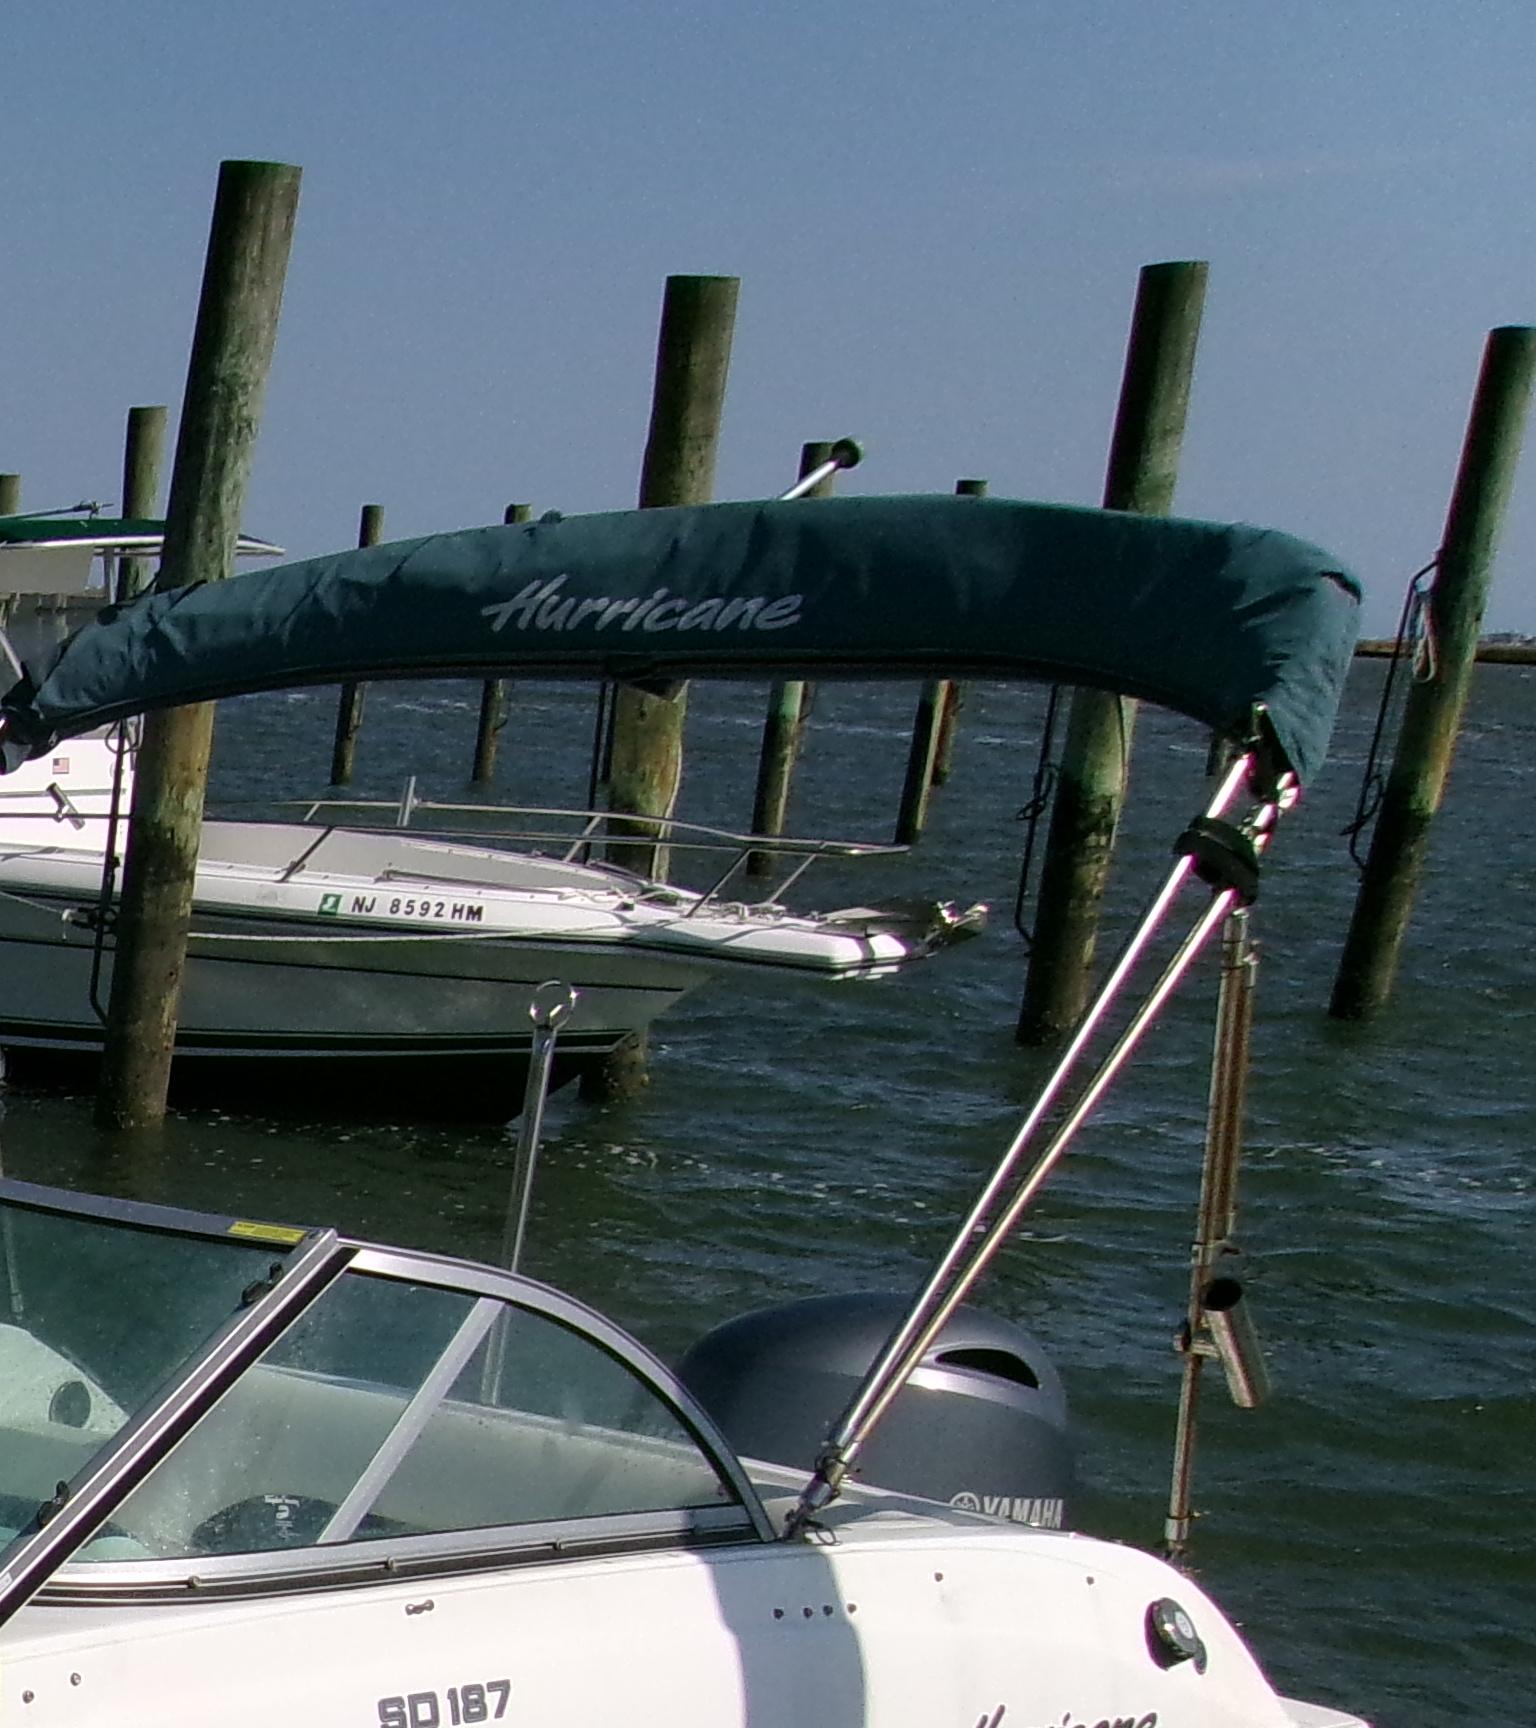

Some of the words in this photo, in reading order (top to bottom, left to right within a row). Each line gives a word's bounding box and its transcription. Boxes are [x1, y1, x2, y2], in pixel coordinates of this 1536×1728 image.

[481, 573, 804, 633] Hurricane
[351, 895, 377, 914] NJ
[389, 898, 445, 918] 8592
[450, 902, 484, 922] HM
[983, 1495, 1065, 1529] YAMAHA
[446, 1679, 511, 1726] 187
